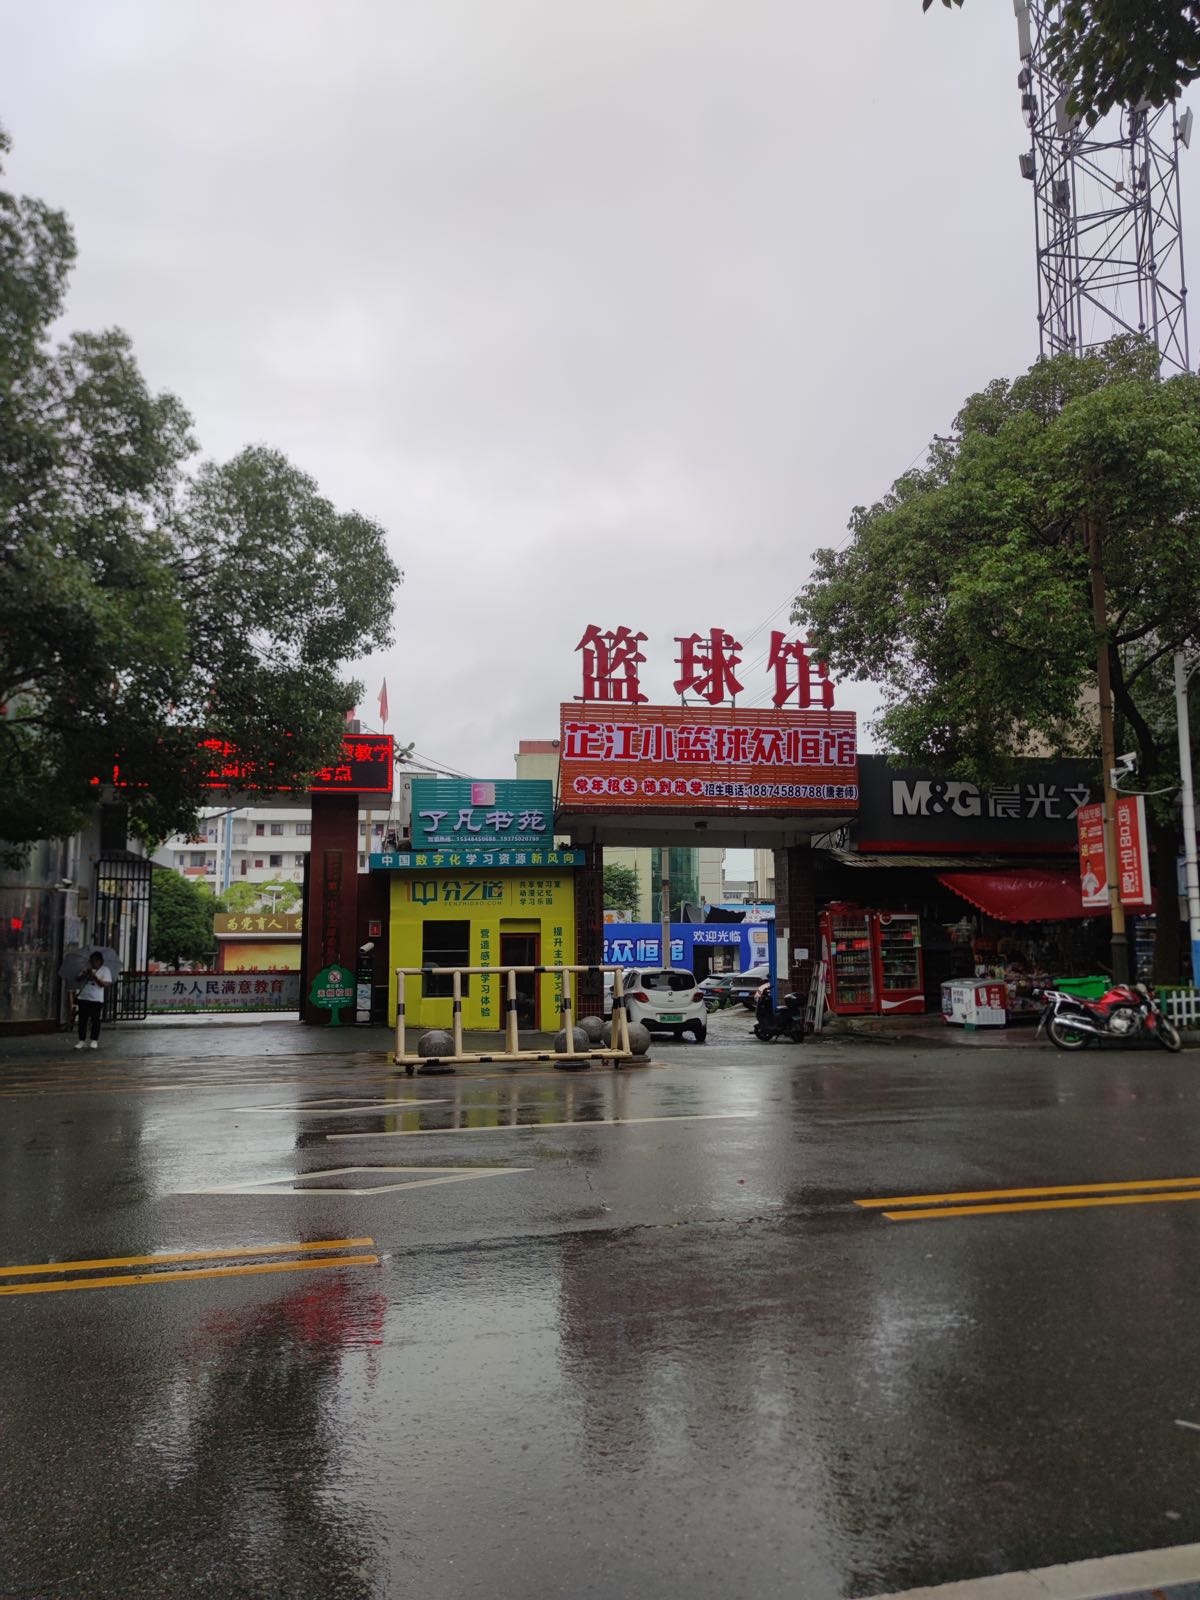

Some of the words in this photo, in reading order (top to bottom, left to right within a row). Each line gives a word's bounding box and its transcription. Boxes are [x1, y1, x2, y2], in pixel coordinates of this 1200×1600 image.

[574, 624, 836, 709] 篮球馆
[563, 722, 857, 767] 芷江小篮球众恒馆
[573, 777, 637, 794] 常年招生
[642, 777, 704, 795] 随到随学
[892, 780, 982, 817] M&G
[419, 809, 547, 833] 了凡书苑
[382, 852, 575, 866] 中国数字化学习资源新风向
[520, 897, 553, 906] 学习乐园
[693, 930, 741, 942] 欢迎光临
[171, 979, 286, 996] 办人民满意教育
